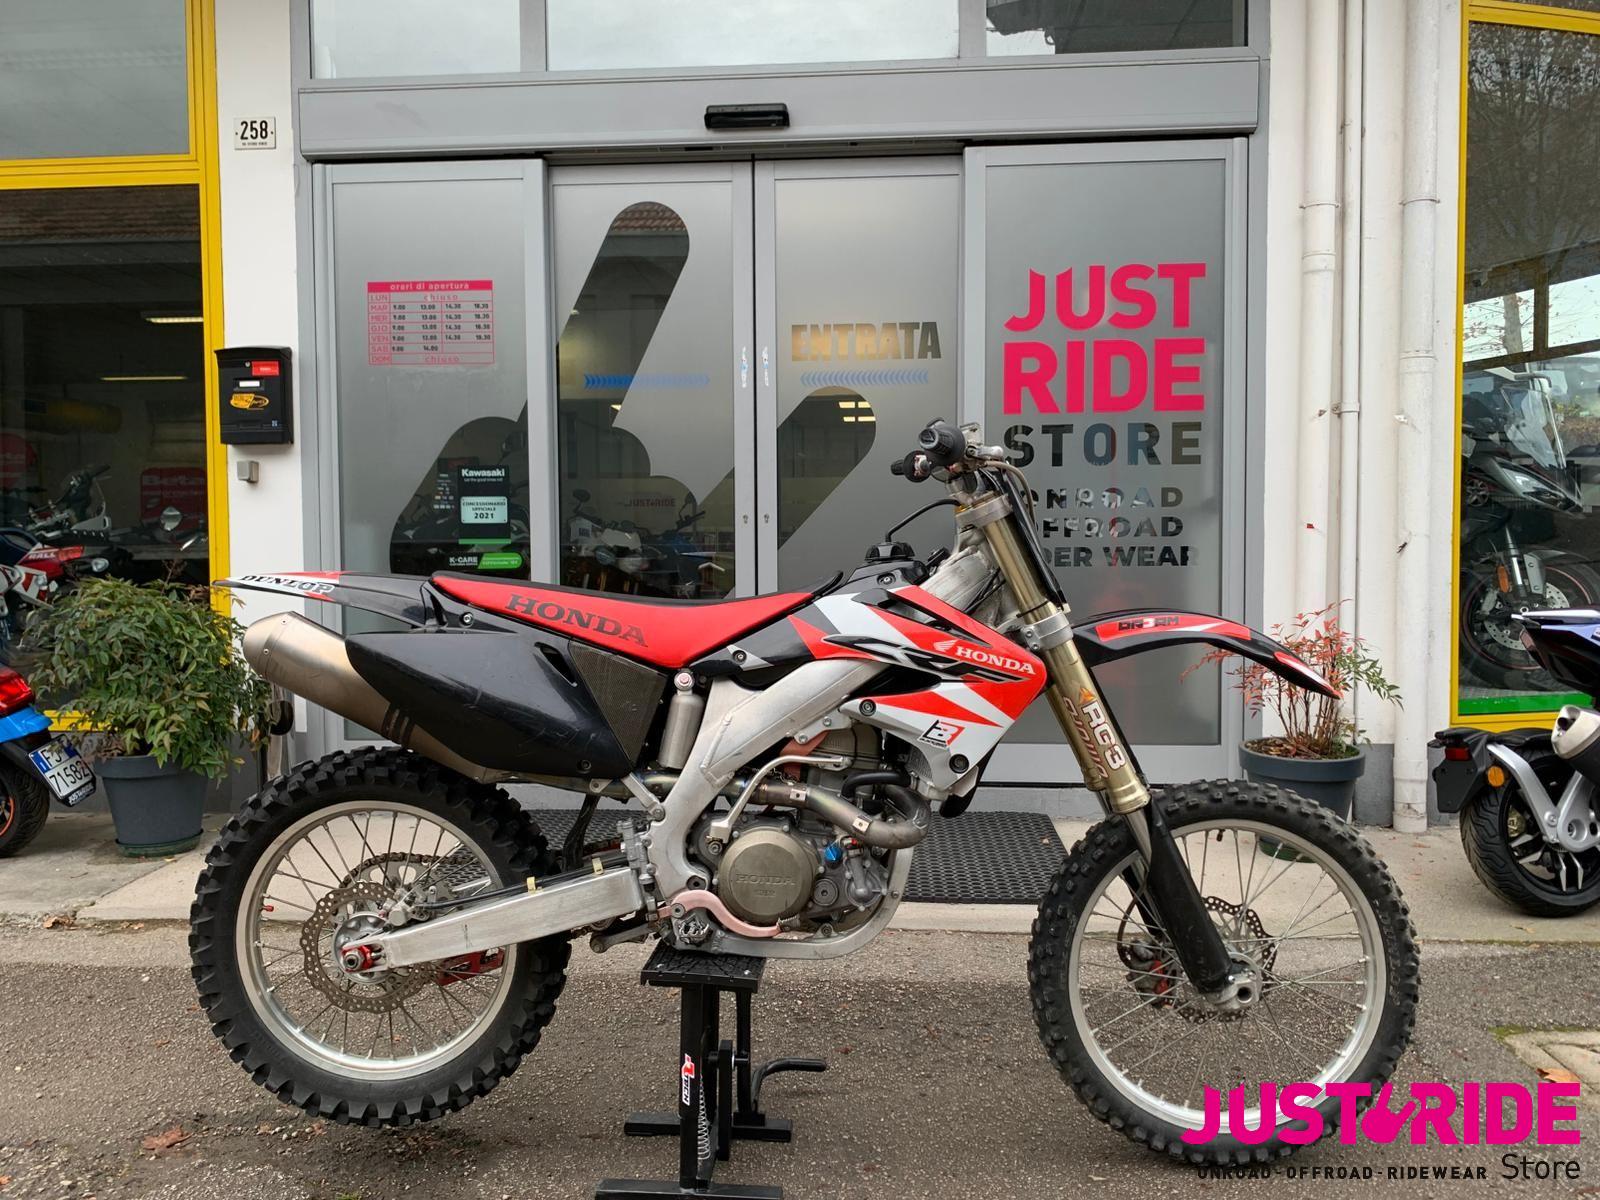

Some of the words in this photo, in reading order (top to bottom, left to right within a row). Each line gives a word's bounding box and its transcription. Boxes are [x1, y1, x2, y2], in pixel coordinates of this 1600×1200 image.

[240, 120, 269, 140] 258
[429, 282, 470, 290] apertura
[1004, 263, 1206, 332] JUST
[791, 321, 941, 361] ENTRATA
[1003, 337, 1205, 415] RIDE
[1003, 422, 1202, 467] STORE
[461, 469, 505, 477] Kawasaki
[1034, 516, 1183, 538] FFROAD
[241, 575, 336, 594] DUNLOP
[504, 594, 649, 648] HONDA
[955, 645, 1036, 675] HONDA
[49, 760, 90, 793] 71582
